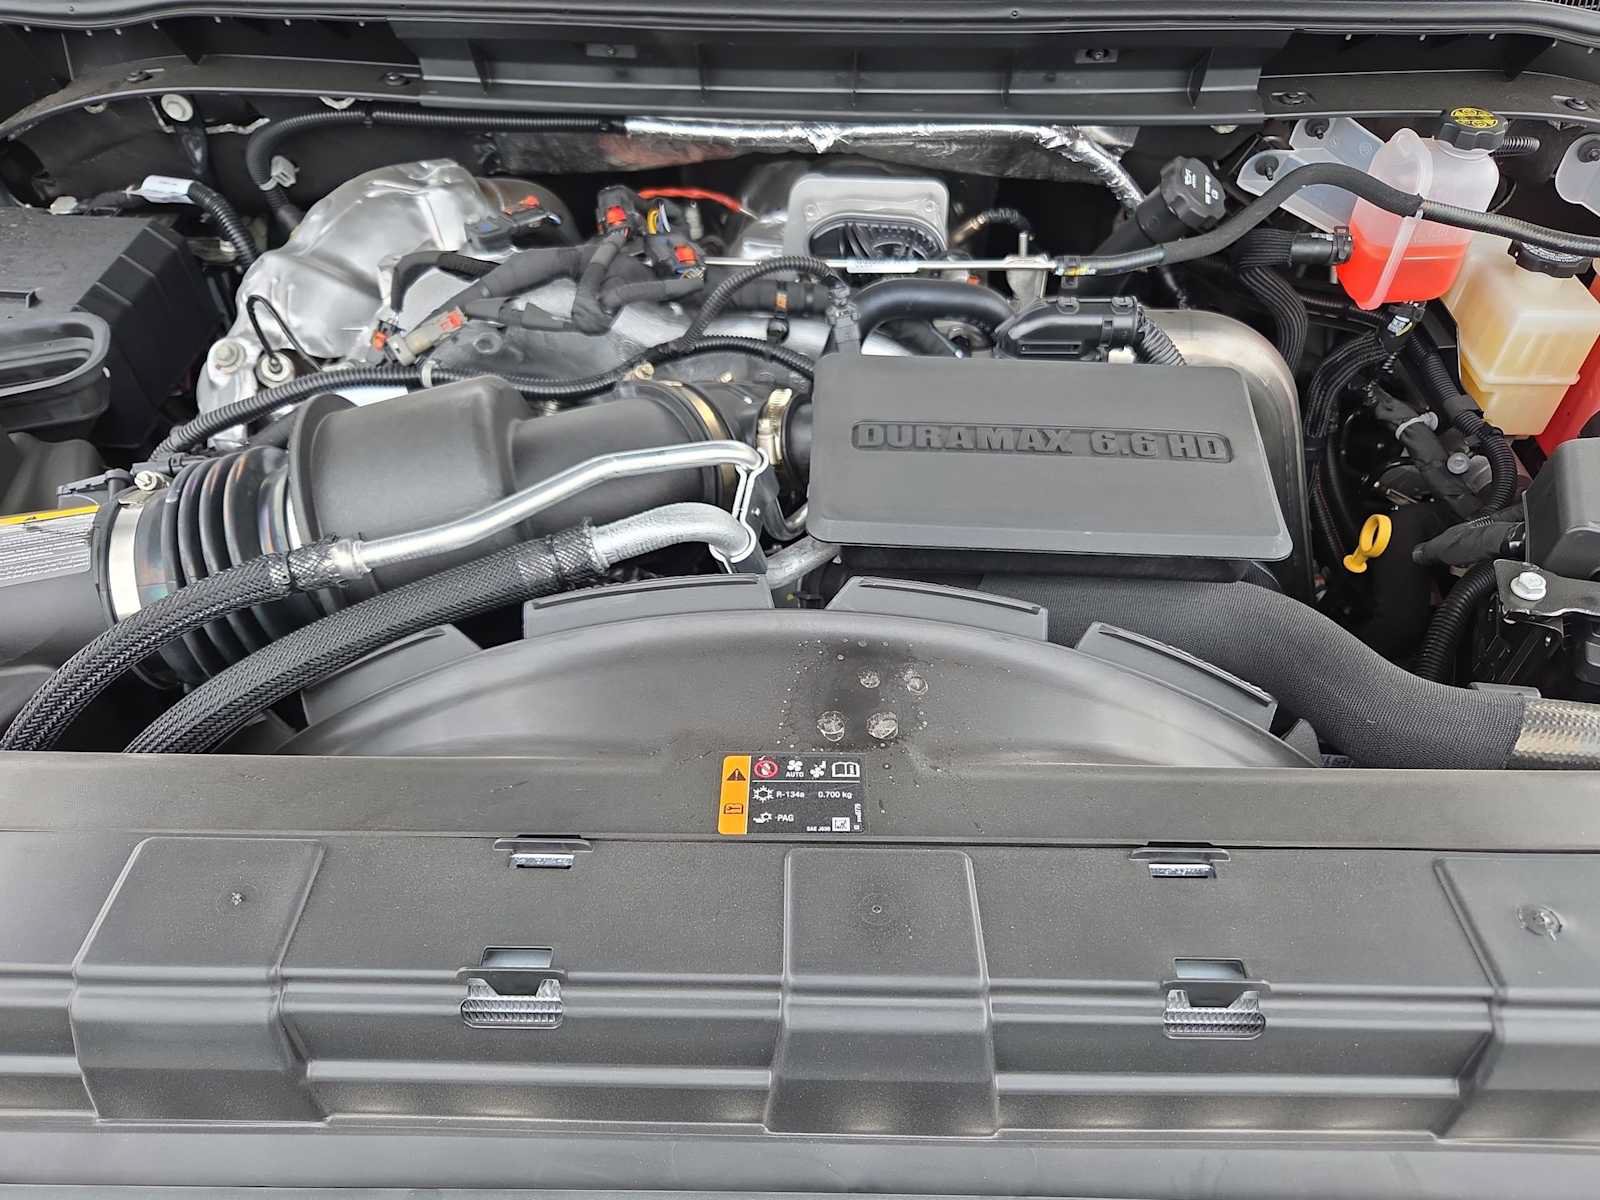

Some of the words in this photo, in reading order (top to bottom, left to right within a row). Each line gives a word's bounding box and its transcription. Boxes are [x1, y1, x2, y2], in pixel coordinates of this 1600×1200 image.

[857, 424, 1073, 454] DURAMAX
[1091, 430, 1157, 457] 6.6
[1168, 434, 1229, 460] HD
[776, 790, 805, 799] R-134a
[818, 791, 841, 799] 0.700
[842, 791, 853, 799] kg
